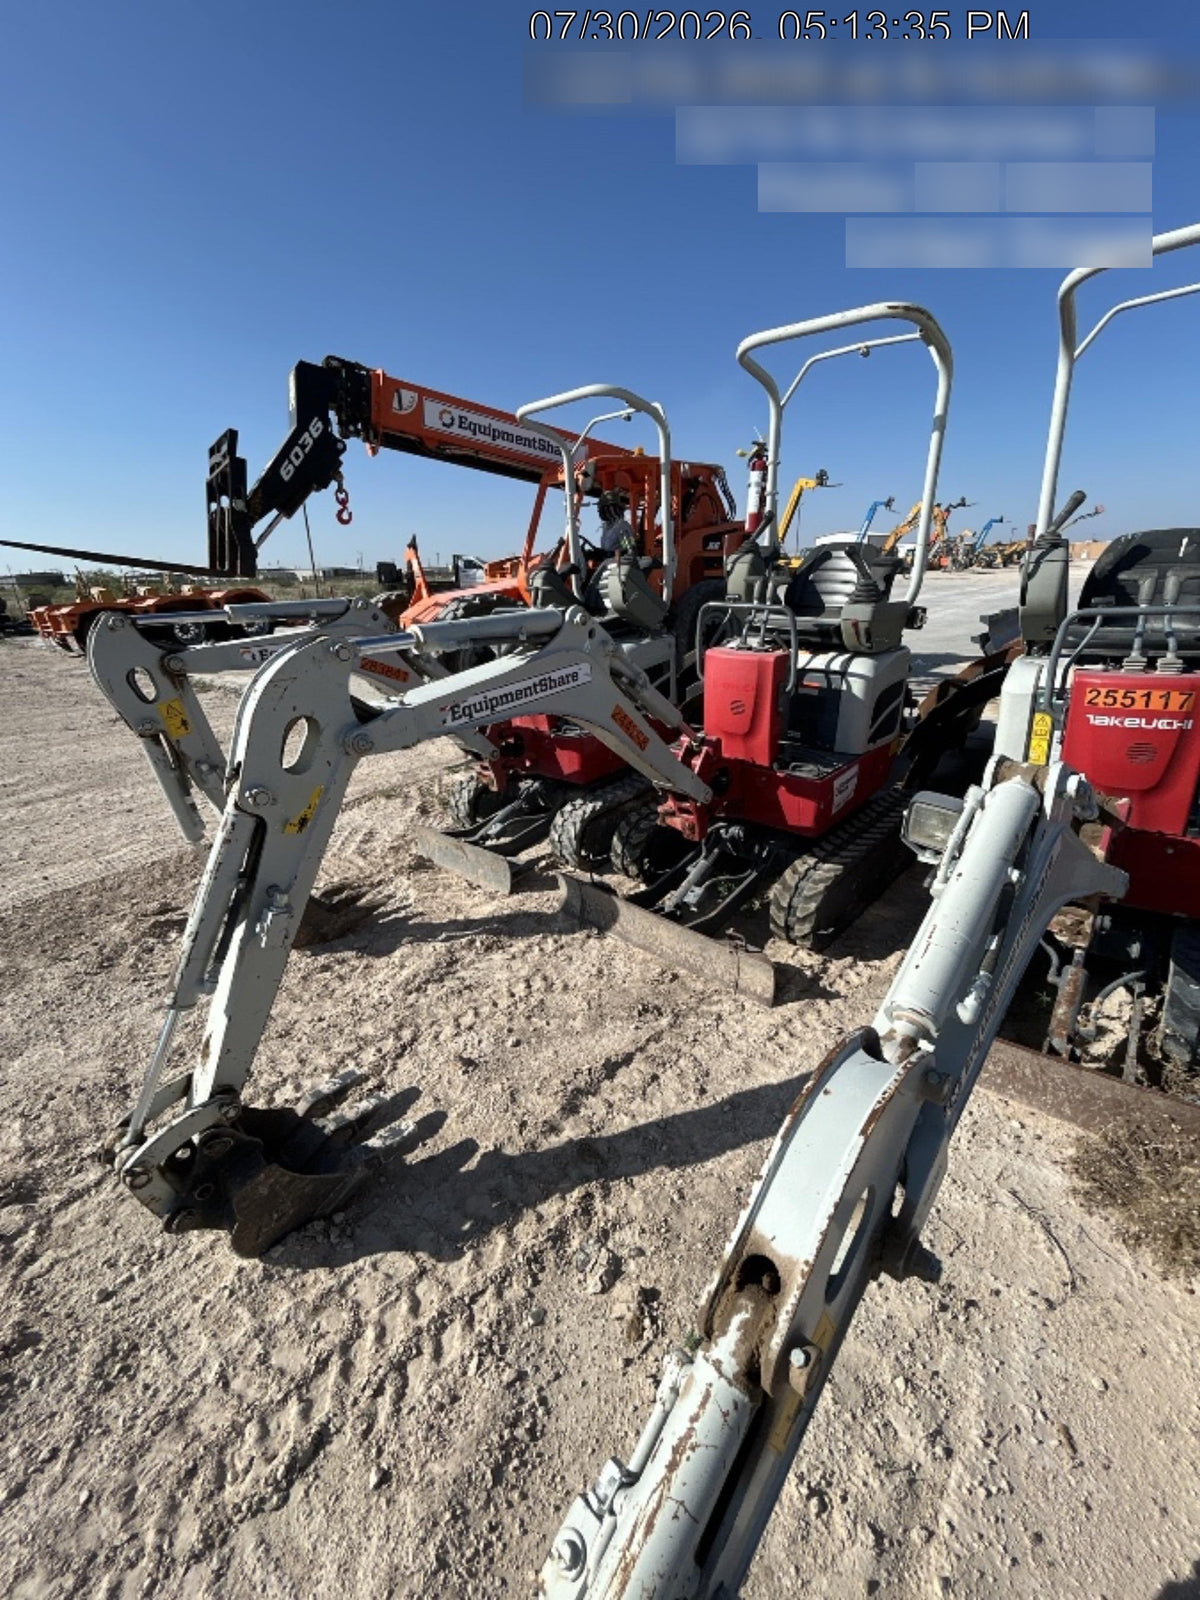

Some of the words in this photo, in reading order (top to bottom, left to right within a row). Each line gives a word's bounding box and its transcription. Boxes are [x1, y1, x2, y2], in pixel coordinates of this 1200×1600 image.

[280, 416, 323, 482] 6036
[458, 414, 564, 457] EquipmentSha
[450, 670, 579, 722] EquipmentShare
[1086, 688, 1194, 710] 255117
